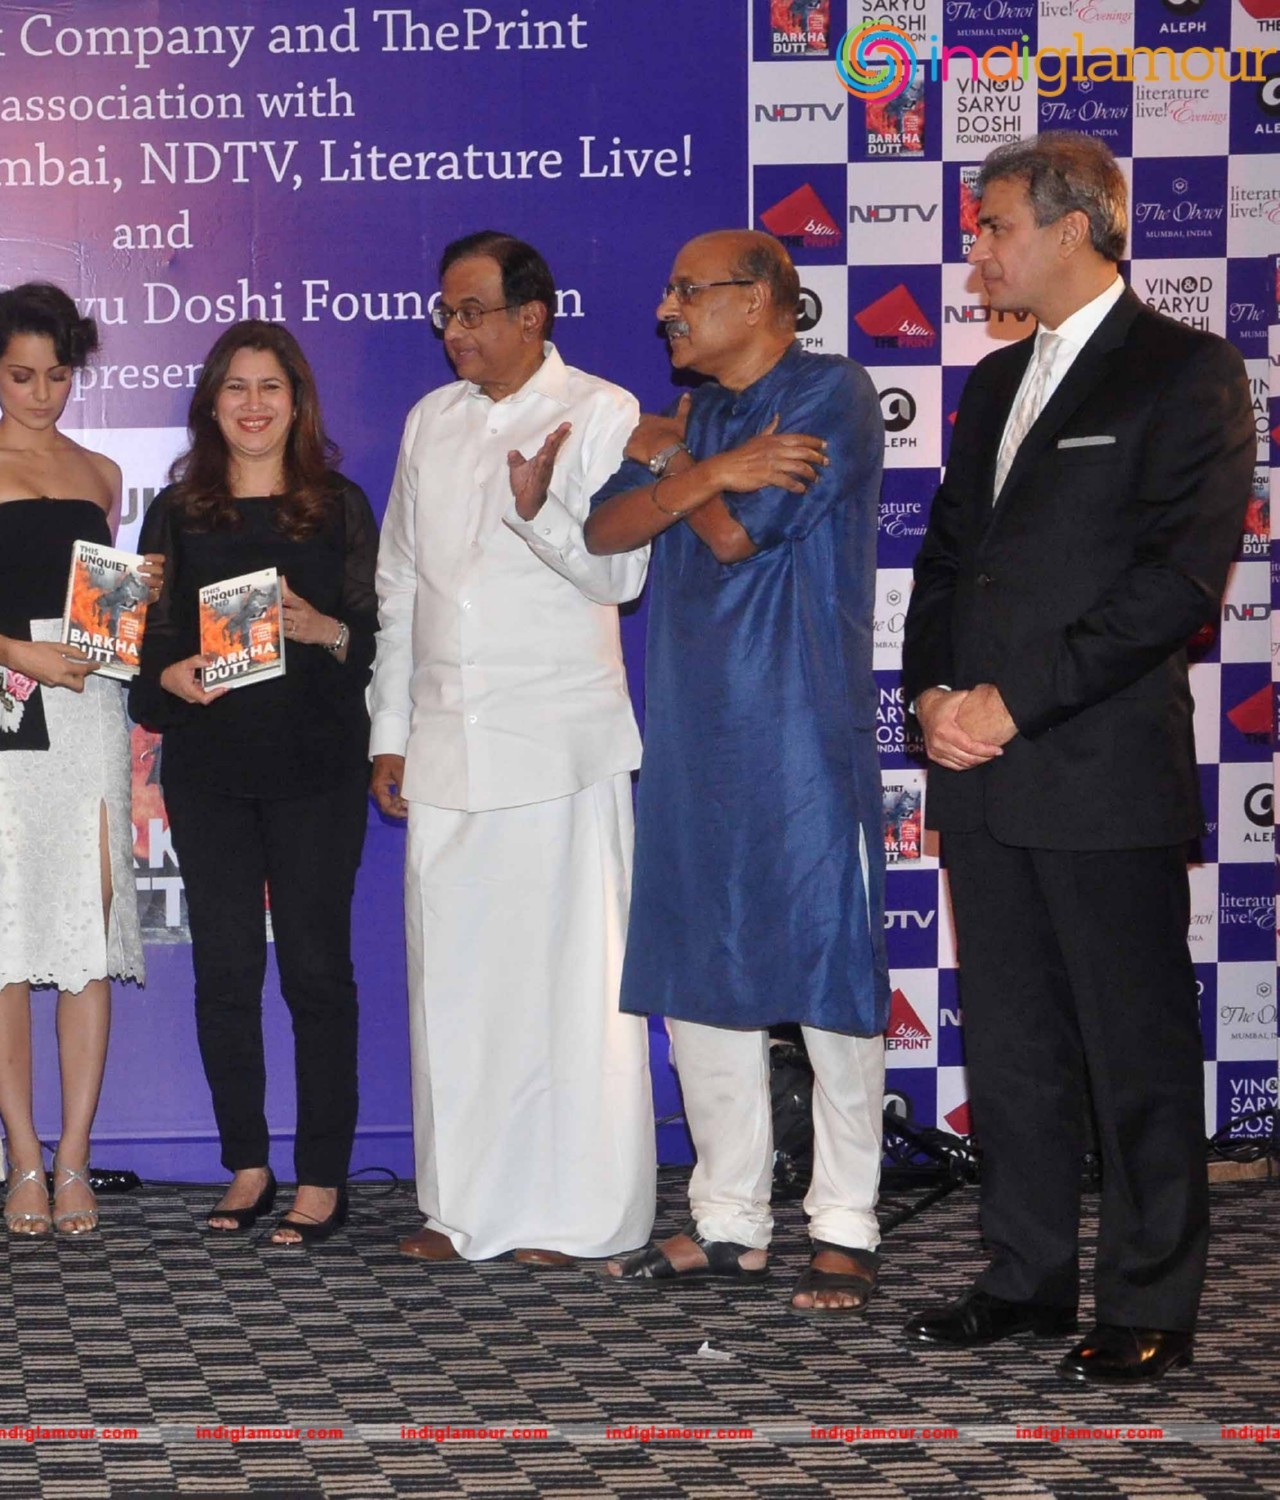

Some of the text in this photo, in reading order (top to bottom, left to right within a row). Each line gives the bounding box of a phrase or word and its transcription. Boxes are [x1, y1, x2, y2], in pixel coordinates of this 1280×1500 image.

[946, 0, 1033, 21] The Oberoi
[1040, 0, 1133, 24] live! Evenings
[773, 32, 825, 42] BARKHA
[998, 28, 1023, 36] INDIA
[1159, 22, 1206, 33] ALEPH
[21, 12, 254, 68] Company
[269, 8, 360, 53] and
[373, 9, 588, 51] ThePrint
[773, 42, 808, 53] DUTT
[1, 83, 244, 121] association
[258, 78, 355, 118] with
[1136, 86, 1209, 100] literature
[755, 103, 844, 122] NDTV
[957, 95, 1020, 112] SARYU
[1041, 101, 1128, 122] The Oberoi
[1136, 100, 1227, 124] live! Evenings
[957, 115, 1020, 132] DOSHI
[868, 133, 920, 143] BARKHA
[956, 133, 1020, 143] FOUNDATION
[868, 143, 902, 154] DUTT
[140, 140, 303, 191] NDTV,
[320, 139, 563, 182] Literature
[579, 134, 693, 178] Live!
[849, 204, 938, 223] NDTV
[1136, 201, 1224, 223] The Oberoi
[1231, 203, 1262, 218] live!
[113, 210, 194, 249] and
[1187, 229, 1213, 237] INDIA
[143, 278, 286, 324] Doshi
[1146, 297, 1209, 313] SARYU
[1230, 303, 1265, 323] The
[80, 545, 99, 556] THIS
[80, 553, 128, 573] UNQUIET
[202, 586, 220, 597] THIS
[203, 584, 252, 605] UNQUIET
[70, 628, 139, 656] BARKHA
[205, 659, 250, 683] DUTT
[1221, 909, 1252, 924] live!
[1220, 1005, 1254, 1026] The
